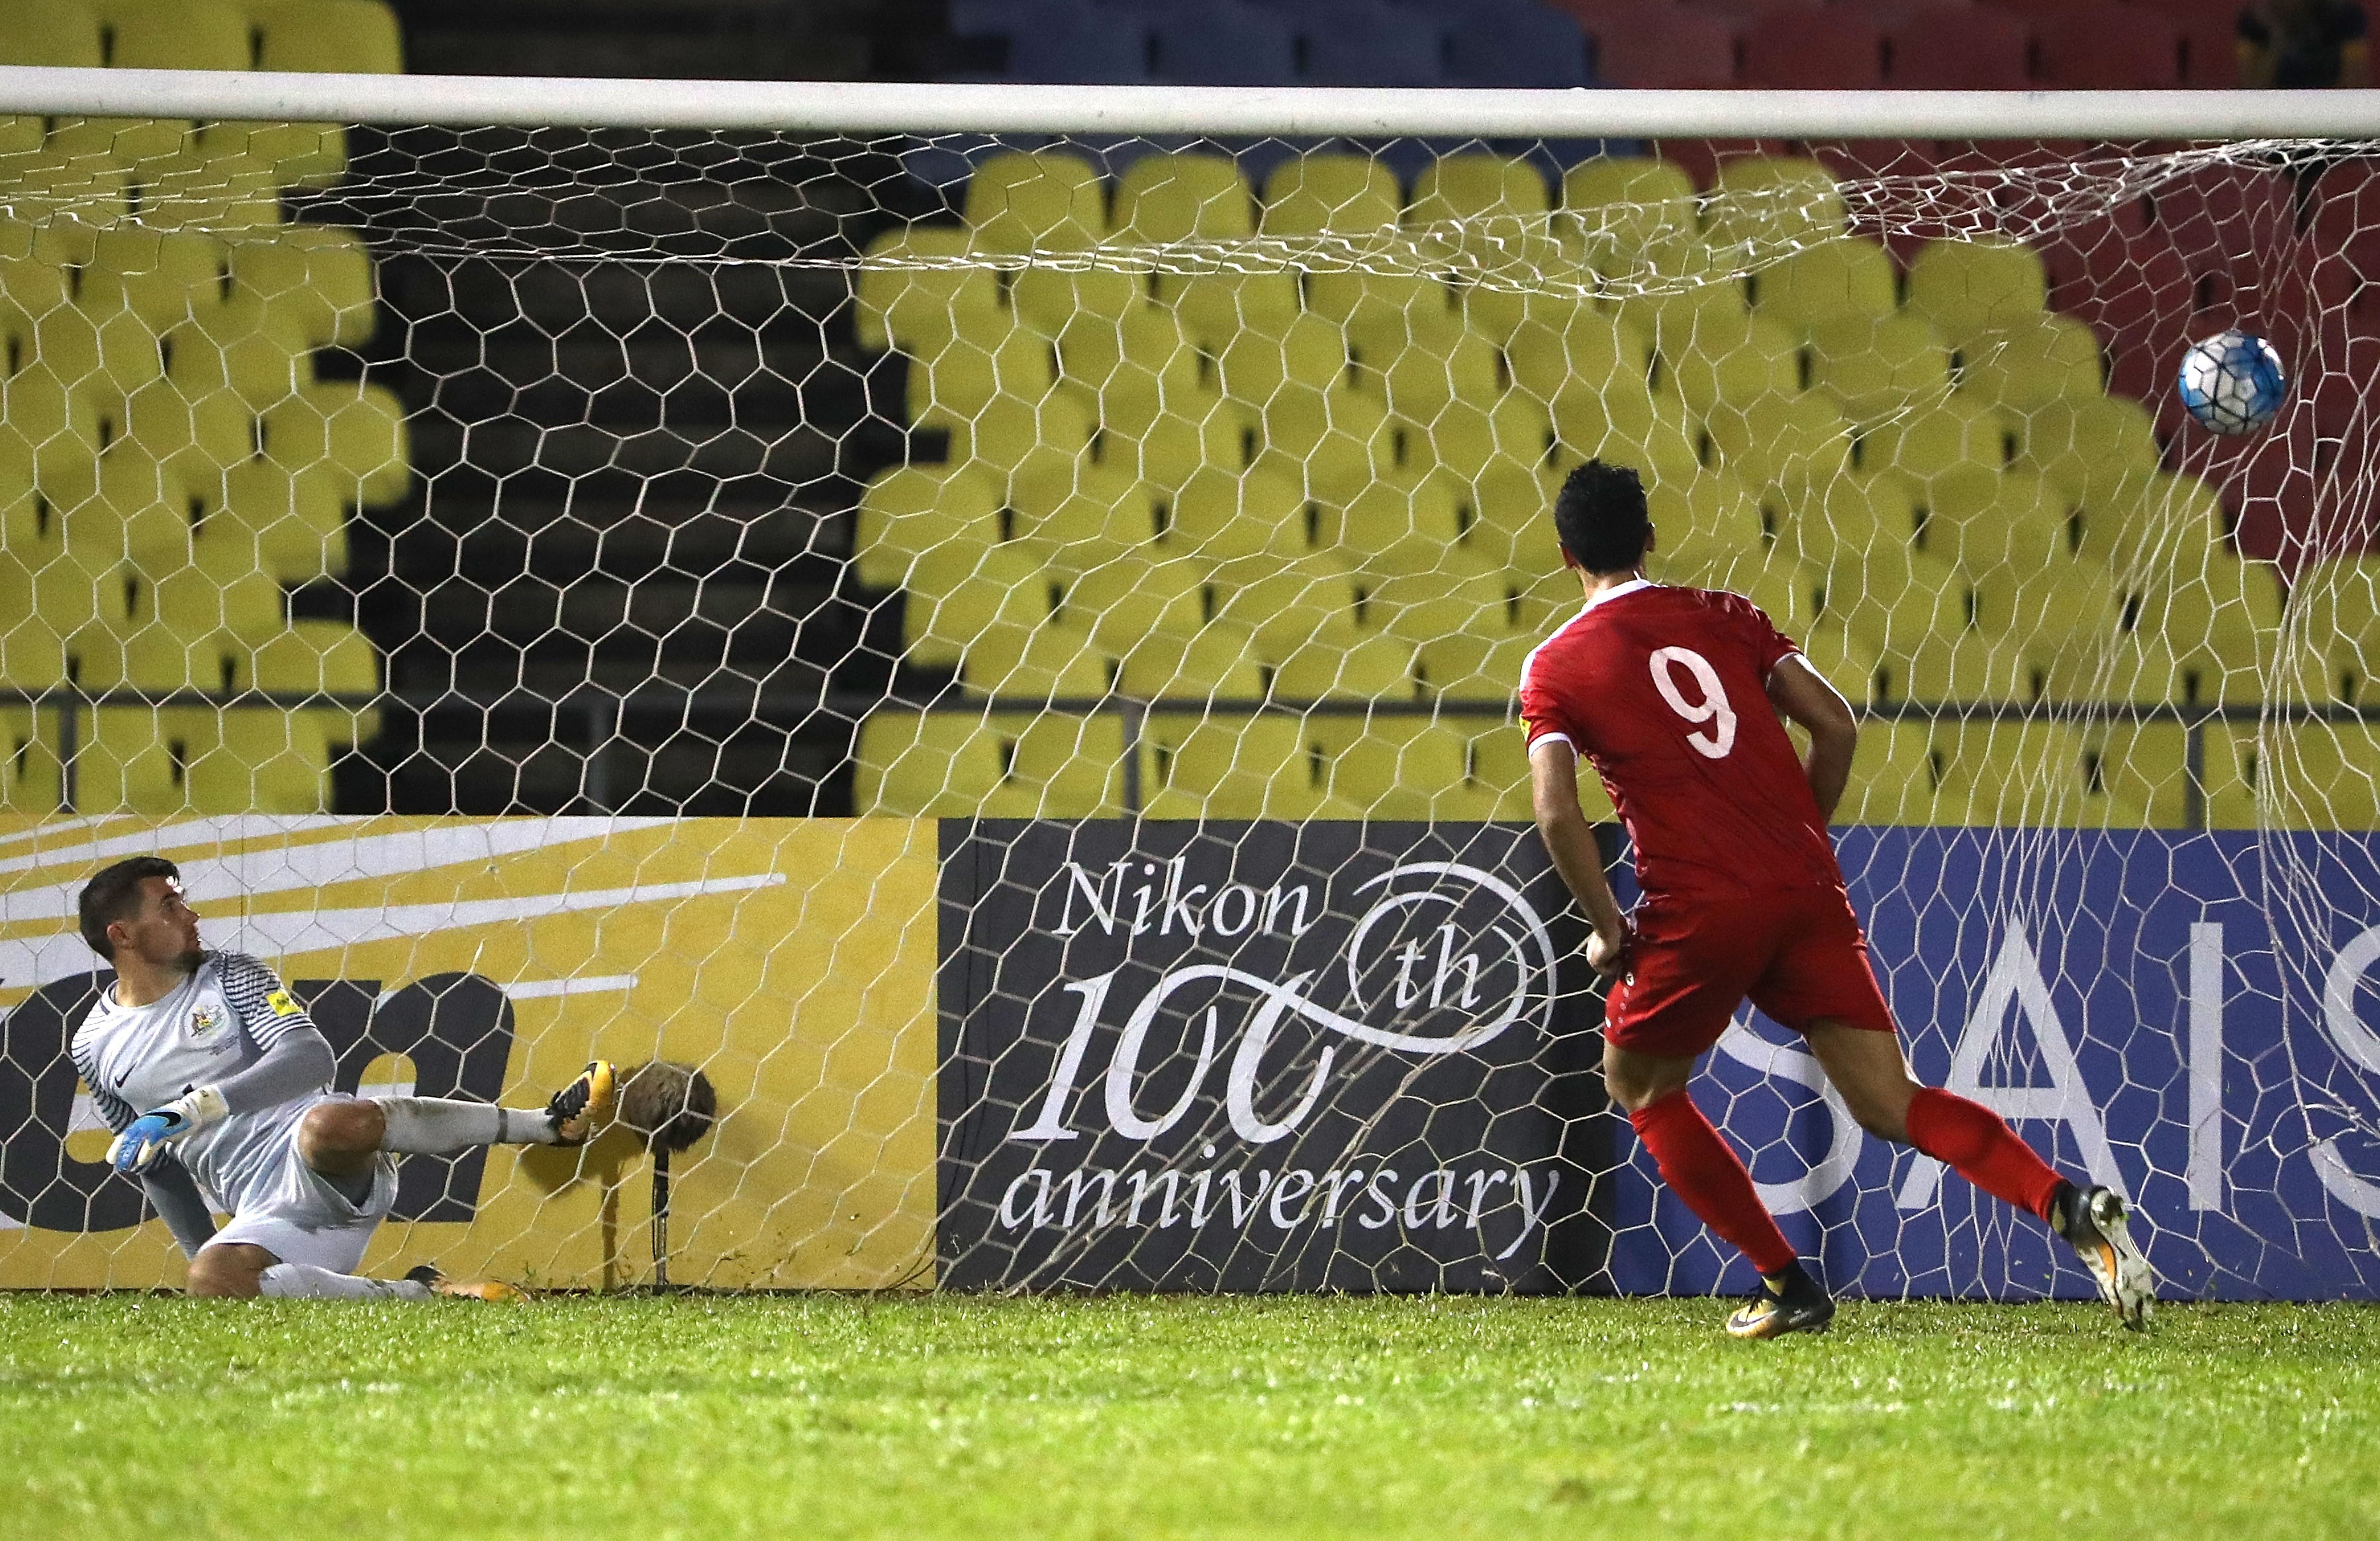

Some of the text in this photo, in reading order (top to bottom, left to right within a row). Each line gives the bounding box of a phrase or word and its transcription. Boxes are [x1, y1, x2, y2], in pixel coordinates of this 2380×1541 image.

[1649, 646, 1737, 759] 9
[1053, 857, 1309, 937] Nikon
[1000, 1144, 1558, 1261] anniversary
